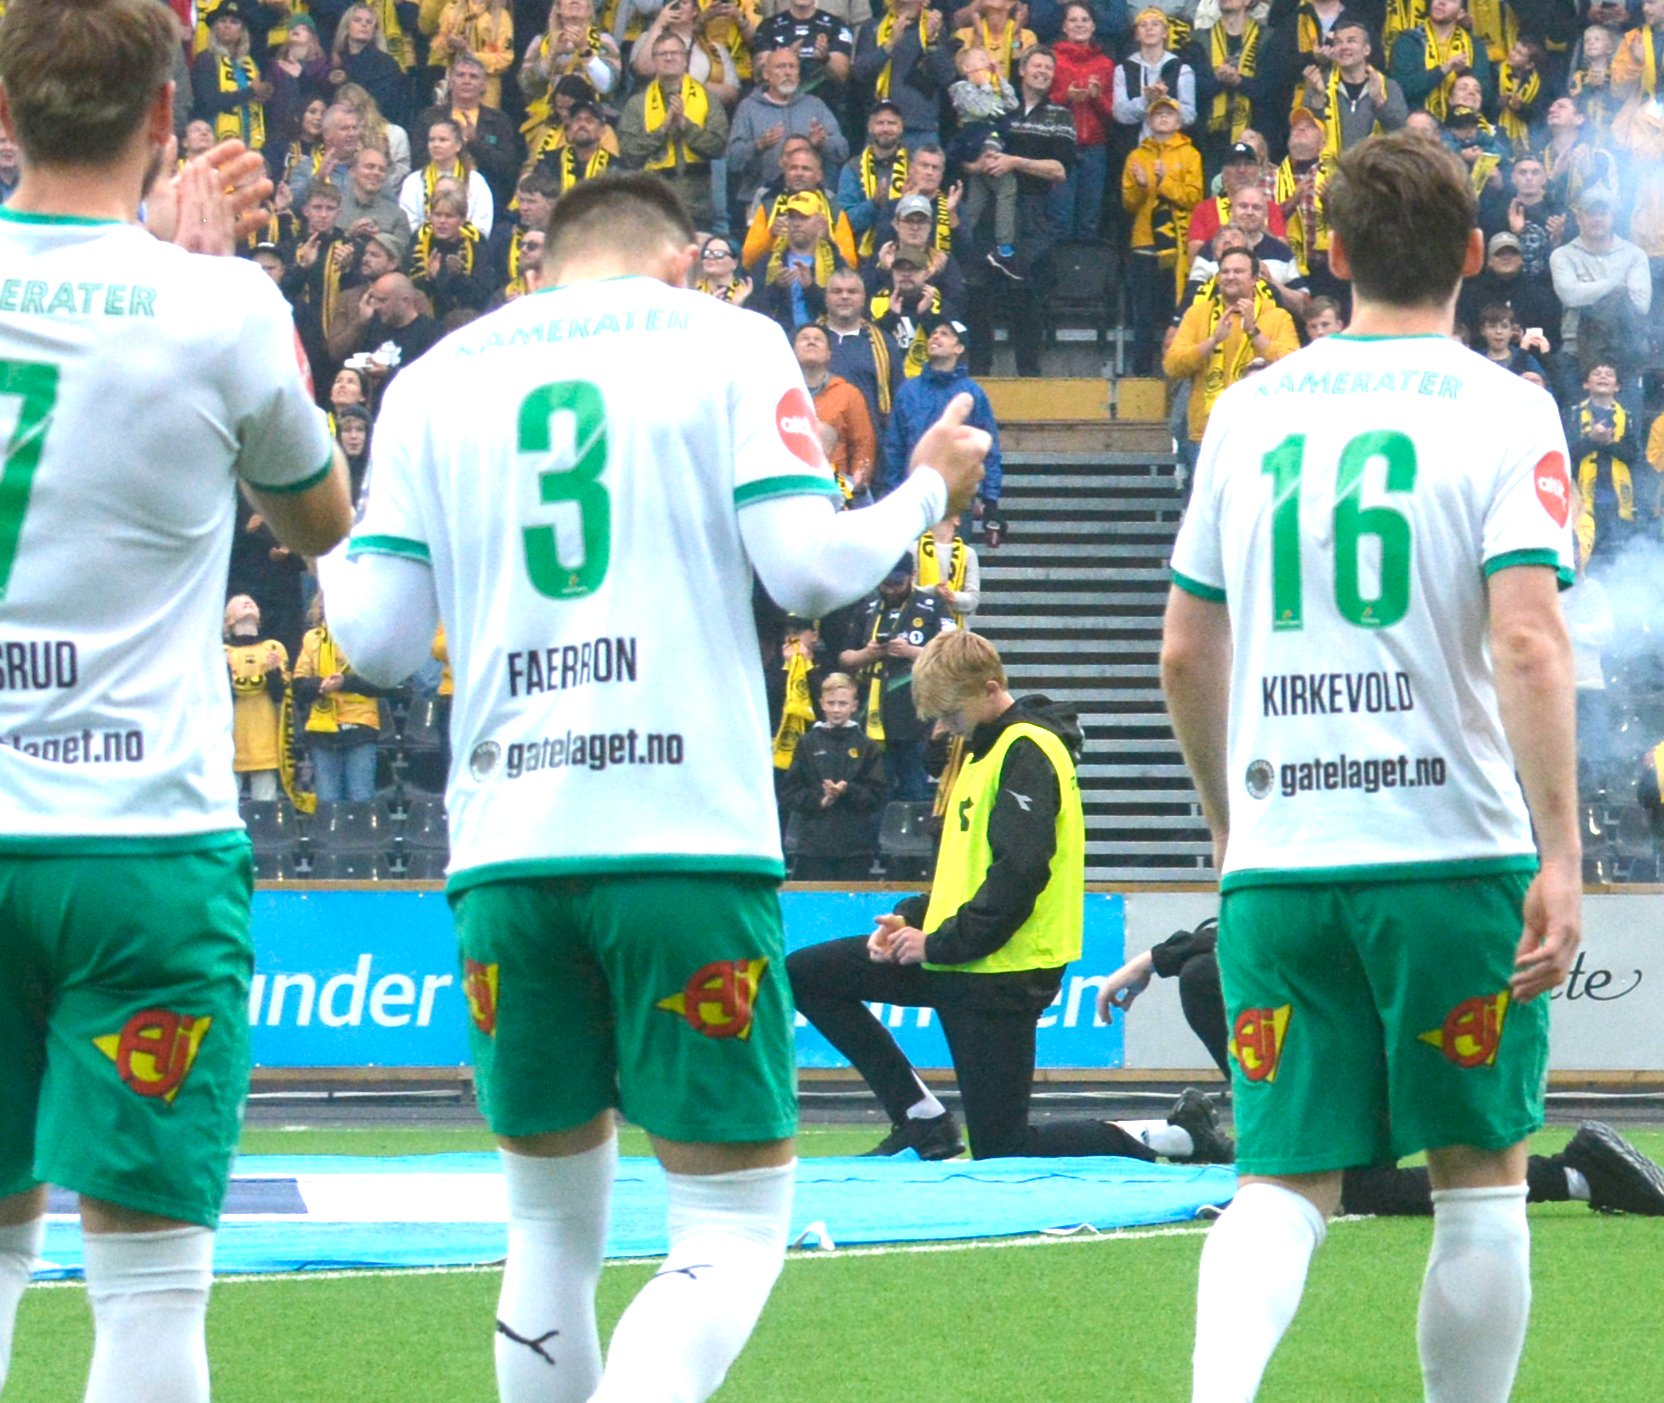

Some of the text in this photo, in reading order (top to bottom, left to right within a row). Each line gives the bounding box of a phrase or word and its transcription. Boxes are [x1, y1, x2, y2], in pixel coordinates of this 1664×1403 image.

[517, 380, 612, 600] 3
[1260, 430, 1420, 634] 16
[508, 637, 636, 697] FAERRON
[1261, 671, 1413, 717] KIRKEVOLD
[506, 729, 684, 779] gatelaget.no
[1280, 754, 1447, 797] gatelaget.no
